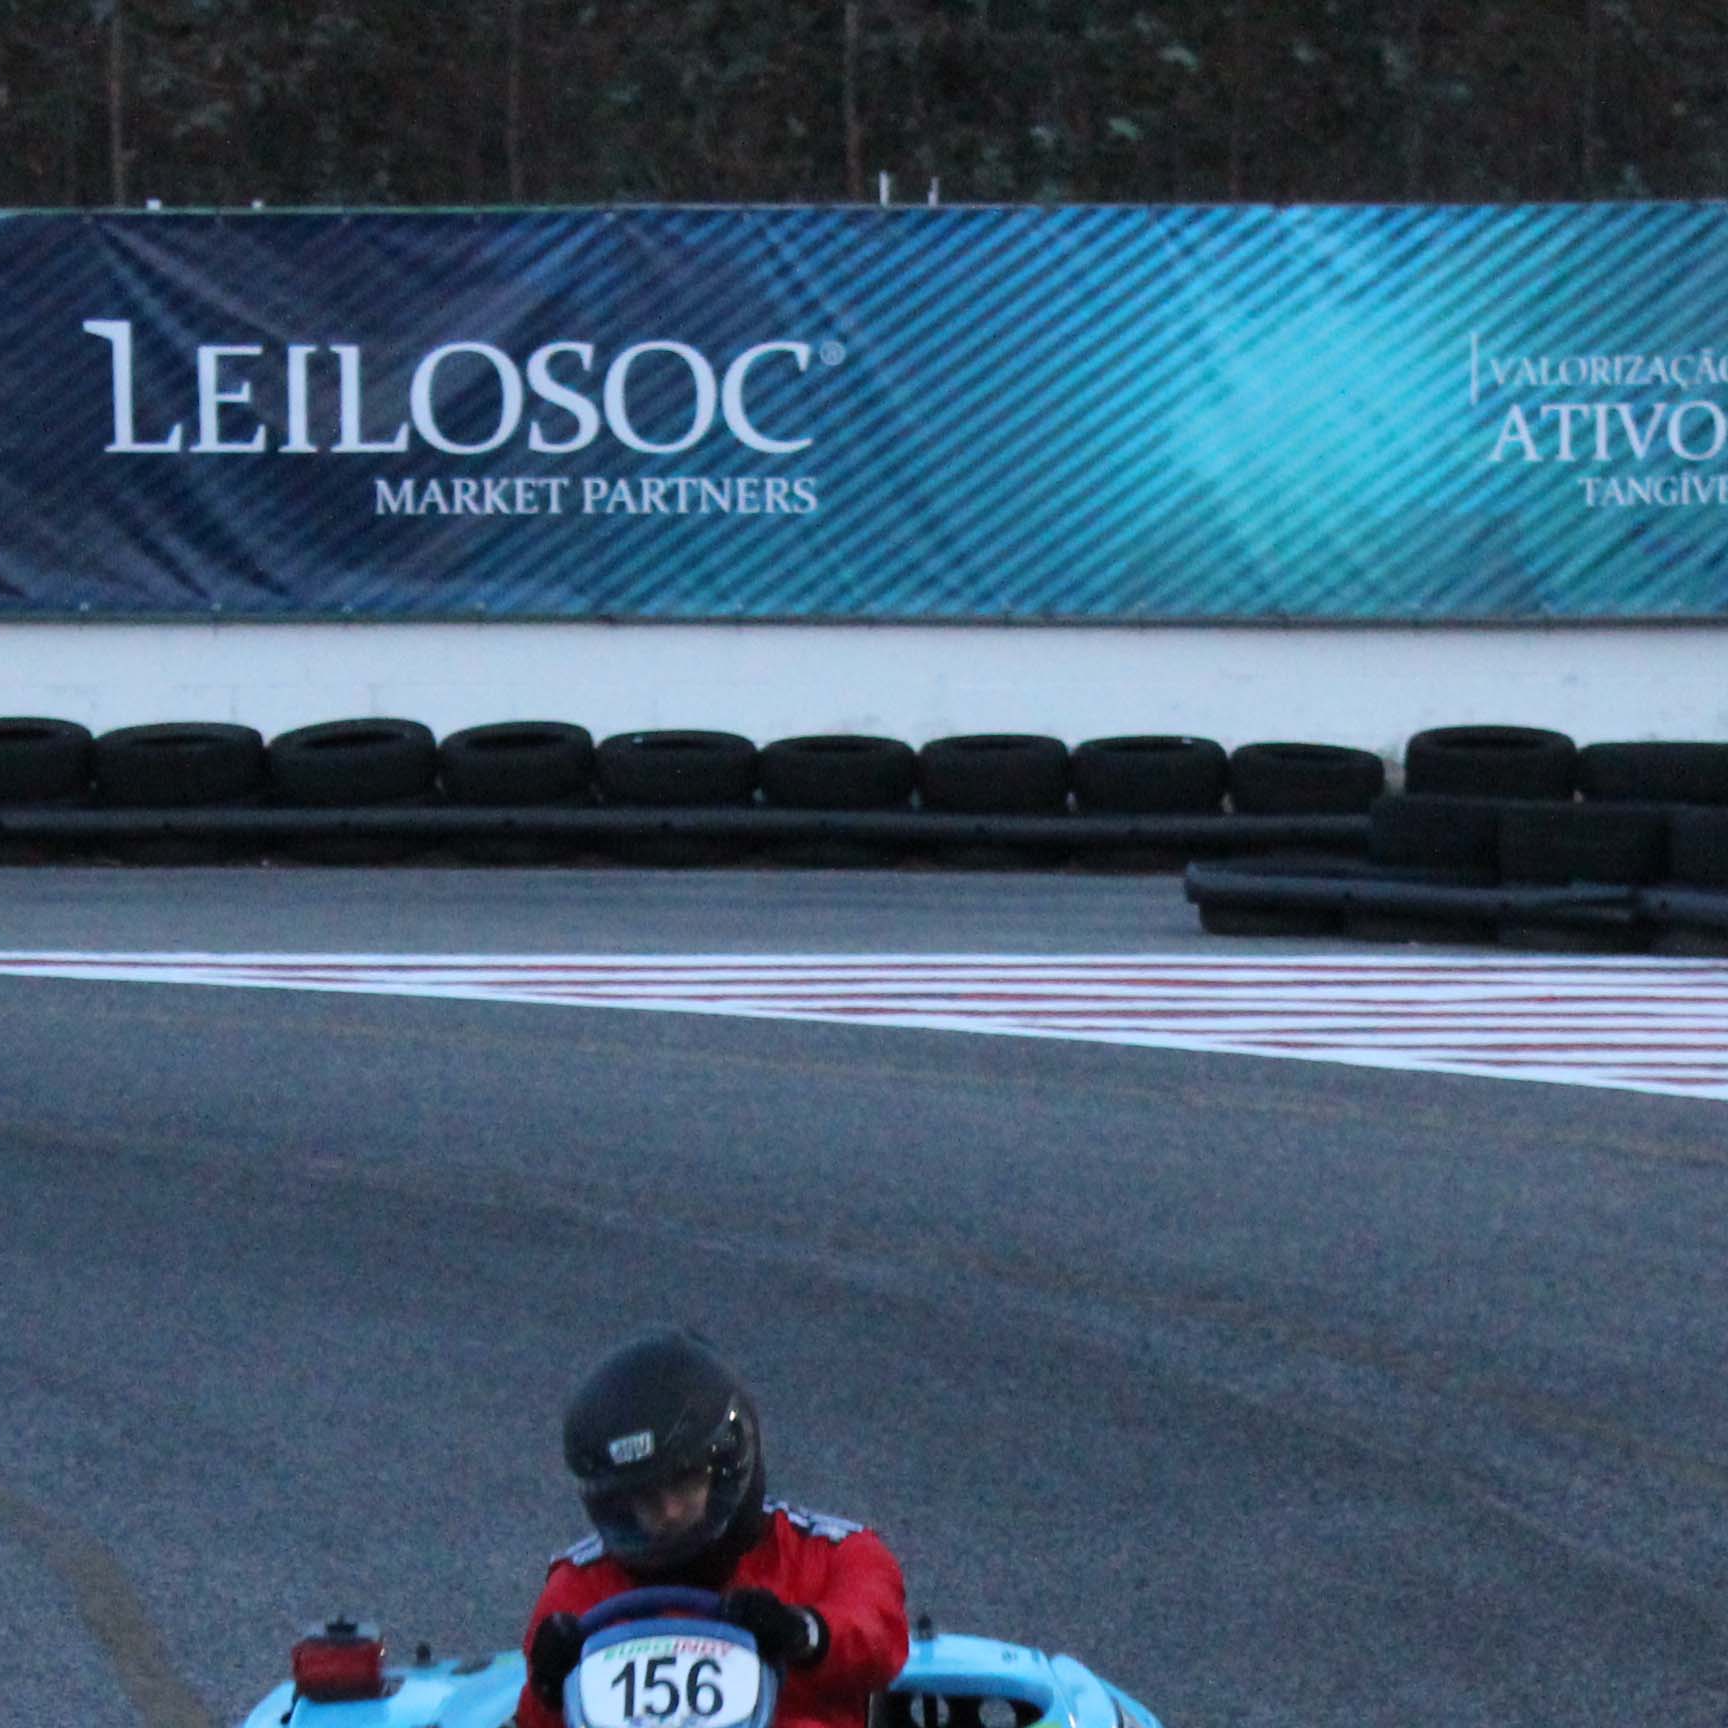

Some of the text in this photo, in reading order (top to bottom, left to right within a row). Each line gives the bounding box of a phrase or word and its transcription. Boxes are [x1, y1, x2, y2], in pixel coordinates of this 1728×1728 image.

[374, 477, 819, 515] MARKET PARTNERS
[611, 1656, 724, 1719] 156
